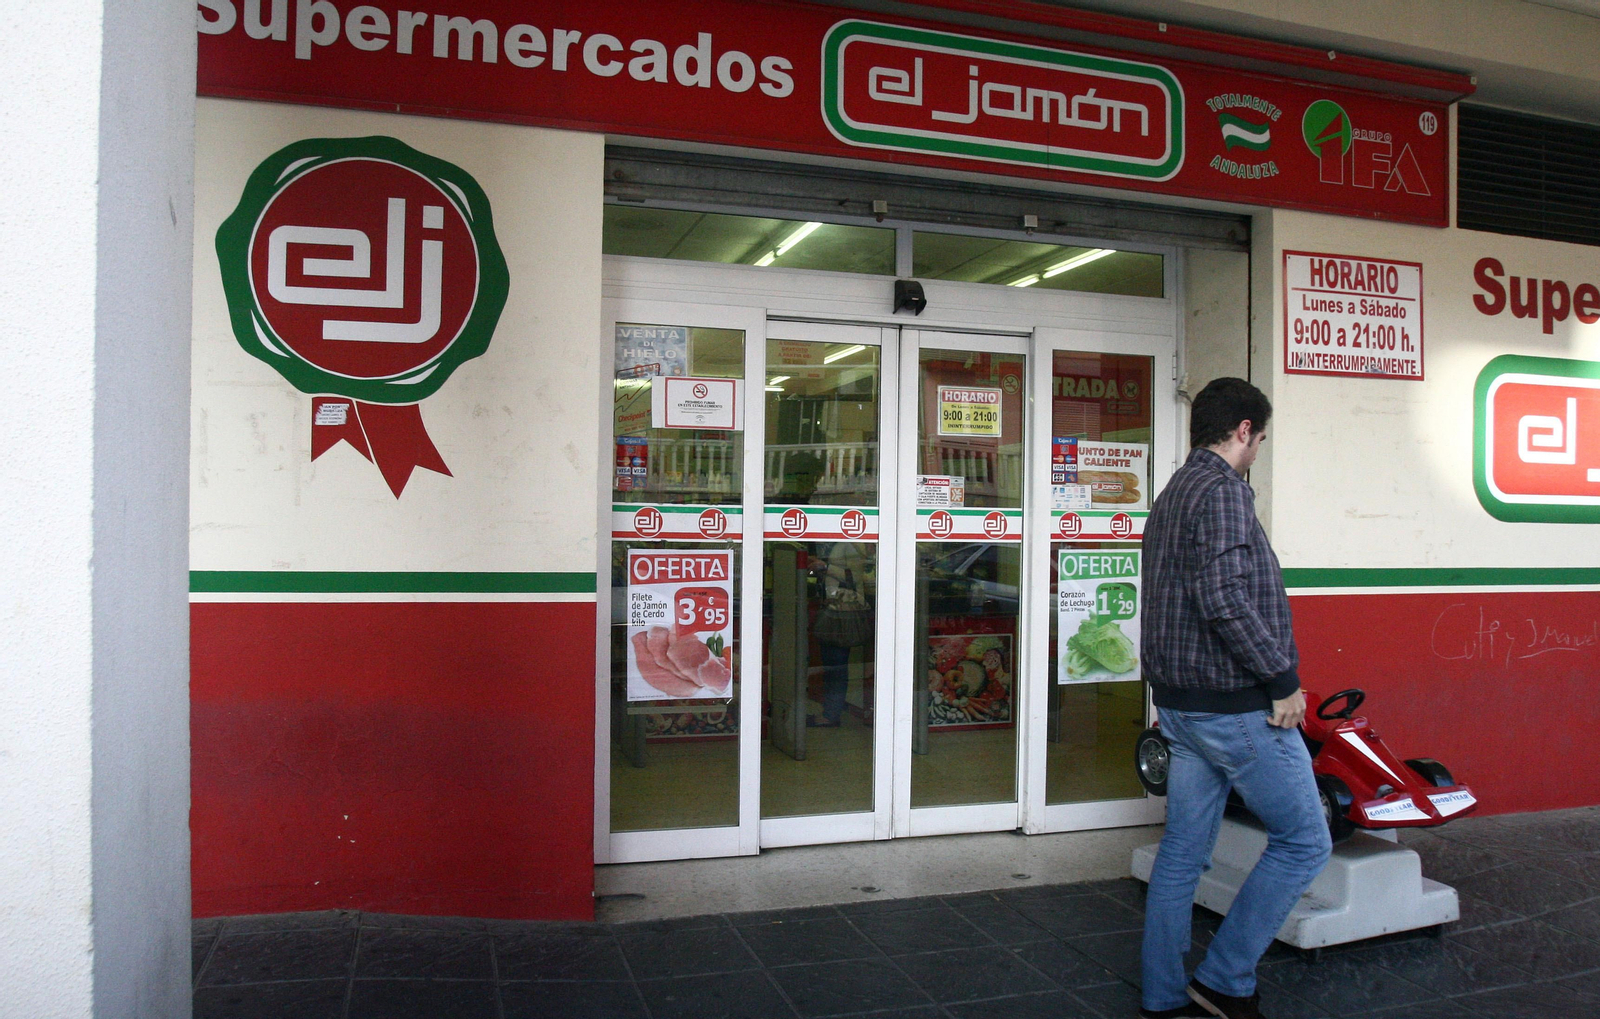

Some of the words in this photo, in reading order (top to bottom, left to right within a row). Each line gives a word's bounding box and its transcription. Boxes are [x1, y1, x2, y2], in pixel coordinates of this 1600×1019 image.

[868, 57, 923, 106] el
[932, 65, 1149, 136] jamón
[1206, 93, 1283, 122] TOTALMENTE
[1421, 115, 1435, 132] 119
[1352, 128, 1392, 142] GRUPO
[1210, 155, 1280, 179] ANDALUZA
[1310, 258, 1399, 294] HORARIO
[1473, 257, 1600, 334] Supe
[1302, 294, 1343, 314] Lunes
[1347, 302, 1355, 314] a
[1360, 299, 1407, 319] Sábado
[620, 329, 680, 339] VENTA
[1294, 318, 1331, 346] 9:00
[1337, 327, 1346, 347] a
[1352, 322, 1396, 351] 21:00
[1401, 327, 1415, 352] h.
[623, 348, 677, 359] HIELO
[944, 390, 996, 403] HORARIO
[943, 410, 963, 421] 9:00
[965, 413, 971, 421] a
[973, 411, 998, 422] 21:00
[1518, 397, 1577, 464] el
[1078, 446, 1106, 457] UNTO
[1108, 448, 1121, 457] DE
[1123, 449, 1143, 458] PAN
[1084, 458, 1131, 468] CALIENTE
[633, 556, 725, 580] OFERTA
[1062, 555, 1136, 576] OFERTA
[631, 593, 653, 601] Filete
[1060, 590, 1086, 598] Corazón
[642, 600, 667, 609] Jamón
[1070, 599, 1095, 608] Lechuga
[631, 610, 641, 618] de
[643, 610, 665, 618] Cerdo
[631, 618, 646, 627] kilo
